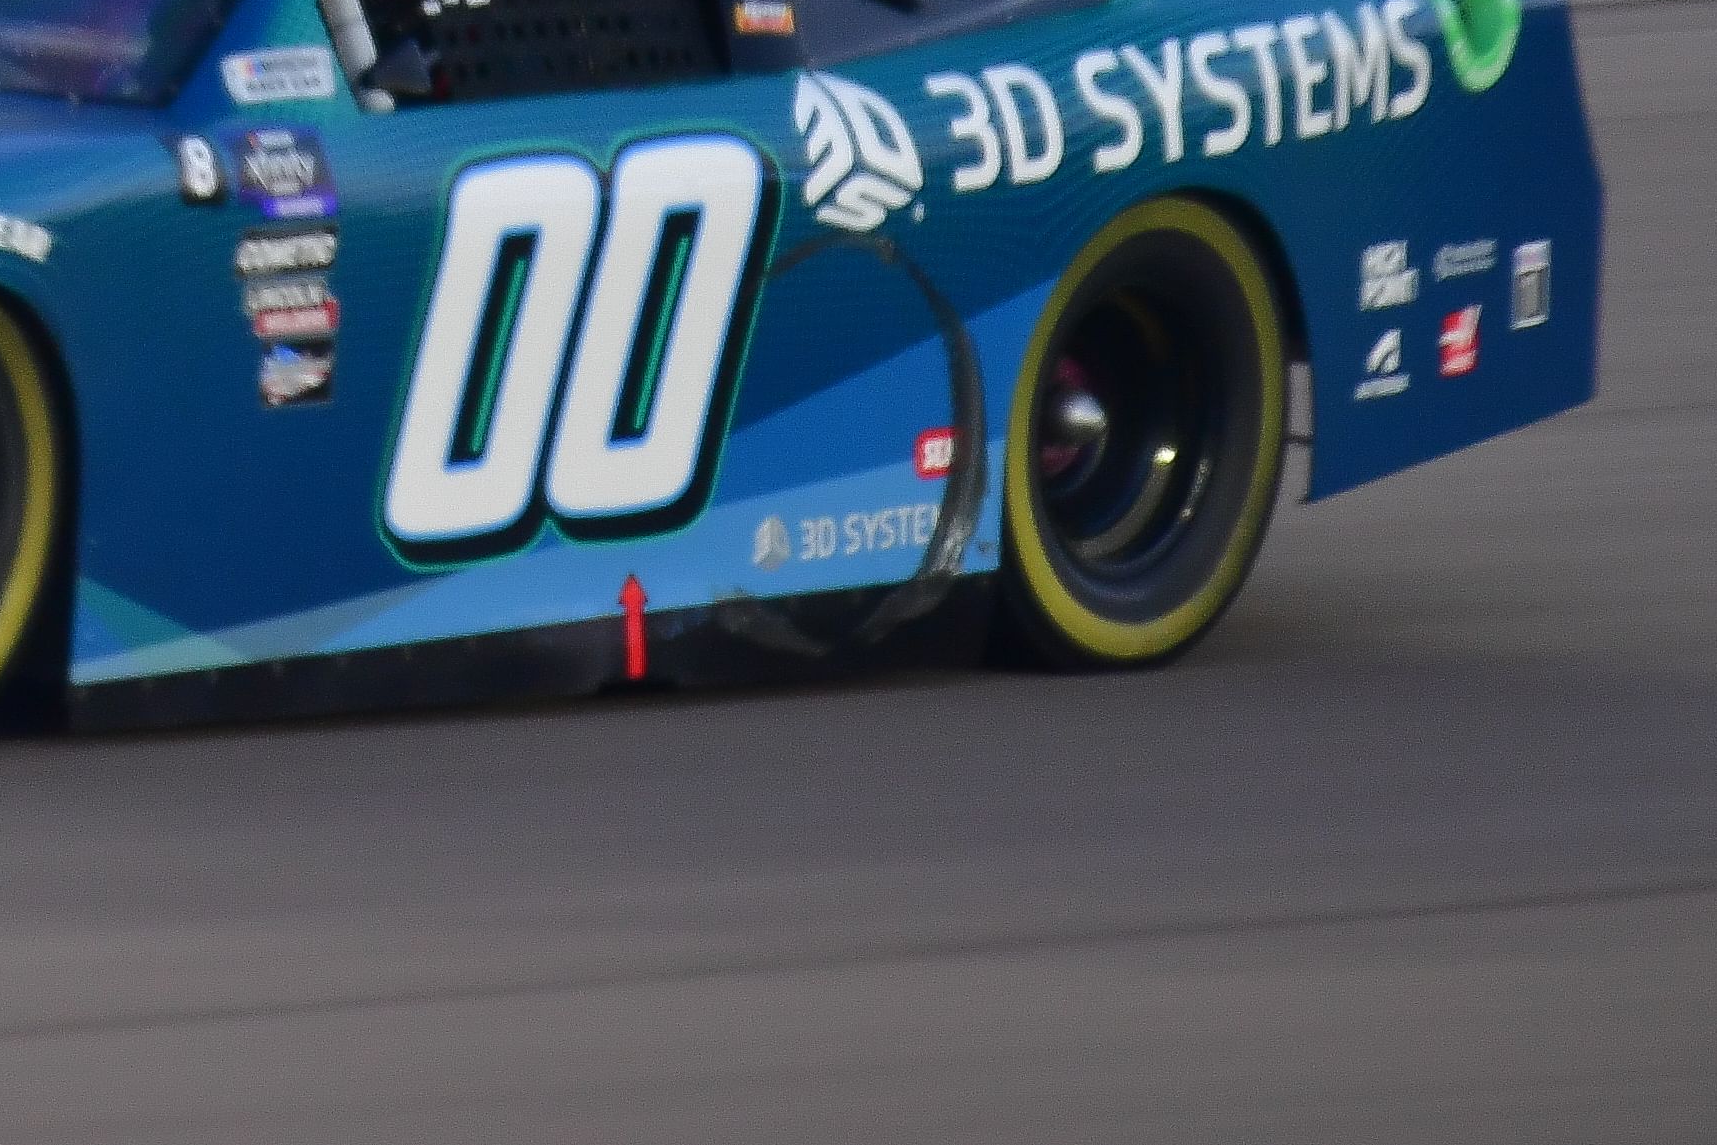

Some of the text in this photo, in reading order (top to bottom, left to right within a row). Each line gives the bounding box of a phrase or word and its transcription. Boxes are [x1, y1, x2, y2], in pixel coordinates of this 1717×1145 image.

[926, 65, 1066, 193] 3D
[383, 131, 765, 543] 00
[799, 516, 837, 561] 3D
